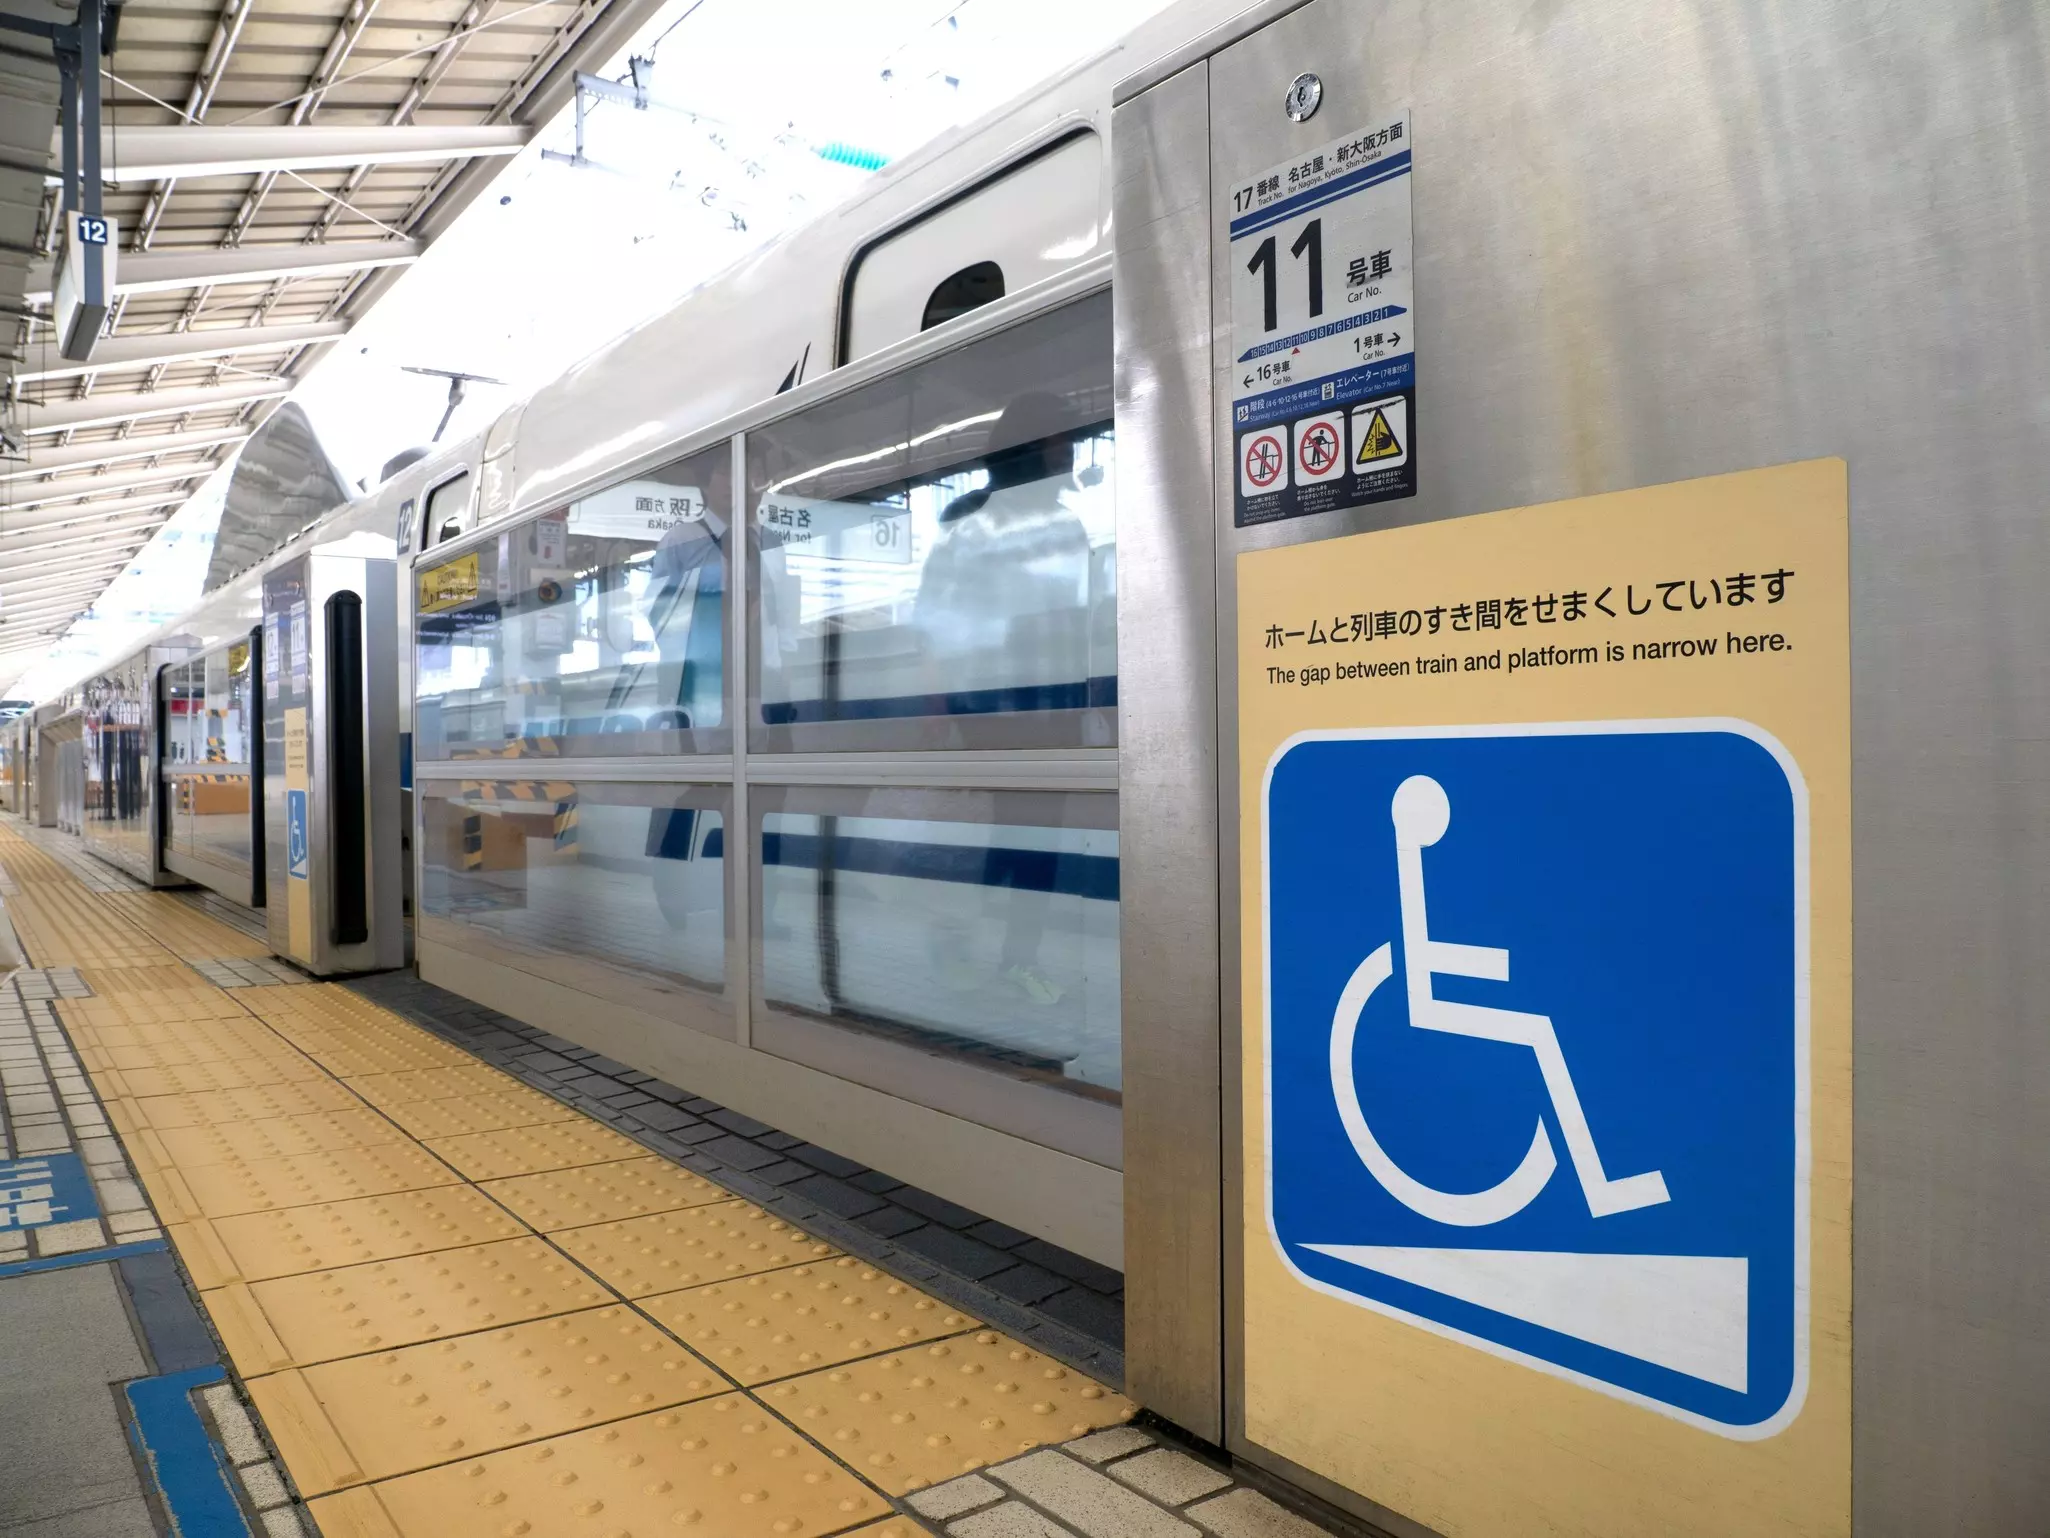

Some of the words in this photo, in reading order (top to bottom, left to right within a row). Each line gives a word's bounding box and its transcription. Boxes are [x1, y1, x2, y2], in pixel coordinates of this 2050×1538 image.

[1288, 185, 1297, 194] for
[1298, 176, 1323, 190] Nagoya,
[1258, 195, 1272, 206] Track
[80, 220, 106, 243] 12
[1247, 217, 1323, 333] 11
[1346, 248, 1392, 287] 号車
[1347, 291, 1363, 303] Car
[1365, 286, 1382, 298] No.
[1363, 352, 1373, 361] Car
[1375, 349, 1385, 358] No.
[1273, 378, 1282, 386] Car
[1283, 375, 1293, 383] No.
[1336, 369, 1380, 388] エレベーター
[1336, 388, 1362, 400] Elevator
[398, 506, 412, 549] 12
[1265, 568, 1796, 650] ホームと列車のすき間をせまくしています
[1266, 666, 1296, 685] The
[1299, 665, 1331, 687] gap
[1336, 657, 1411, 681] between
[1416, 654, 1458, 676] train
[1463, 650, 1501, 672] and
[1507, 642, 1599, 674] platform
[1605, 640, 1625, 662] is
[1632, 634, 1718, 660] narrow
[1726, 630, 1794, 656] here.
